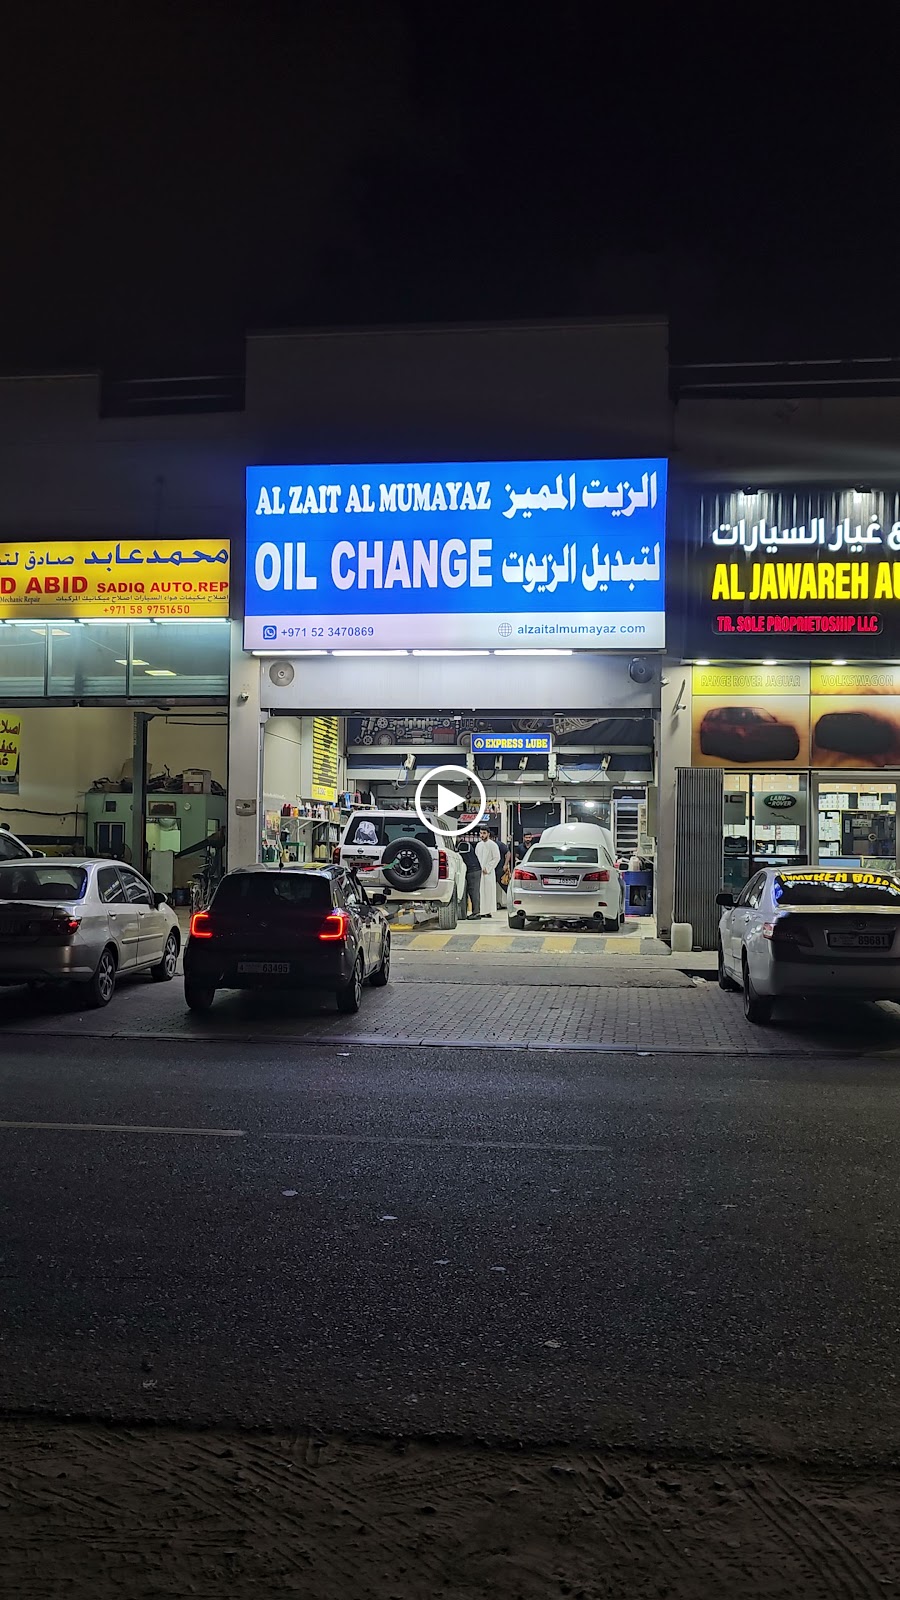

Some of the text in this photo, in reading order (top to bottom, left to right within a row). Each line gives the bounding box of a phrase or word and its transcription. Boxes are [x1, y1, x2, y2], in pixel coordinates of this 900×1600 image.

[255, 481, 492, 515] AL ZAIT AL MUMAYAZ
[502, 470, 657, 518] الزيت المميز
[712, 517, 826, 554] السيارات
[828, 514, 882, 553] غيار
[24, 550, 75, 571] صادق
[84, 543, 144, 573] عابد
[146, 548, 229, 566] محمد
[255, 538, 493, 591] OIL CHANGE
[501, 541, 660, 592] لتبديل الزيوت
[25, 576, 88, 594] ABID
[97, 582, 145, 593] SADIQ
[711, 563, 745, 600] AL
[749, 562, 869, 600] JAWAREH
[103, 605, 190, 615] +971 58 9751650
[281, 626, 374, 637] +971 52 3470869
[736, 615, 765, 632] SOLE
[766, 615, 856, 632] PROPRIETOSHIP
[857, 615, 878, 632] LLC
[700, 674, 801, 687] RANGE ROVER JAGUAR
[485, 738, 548, 749] EXPRESS LUBE
